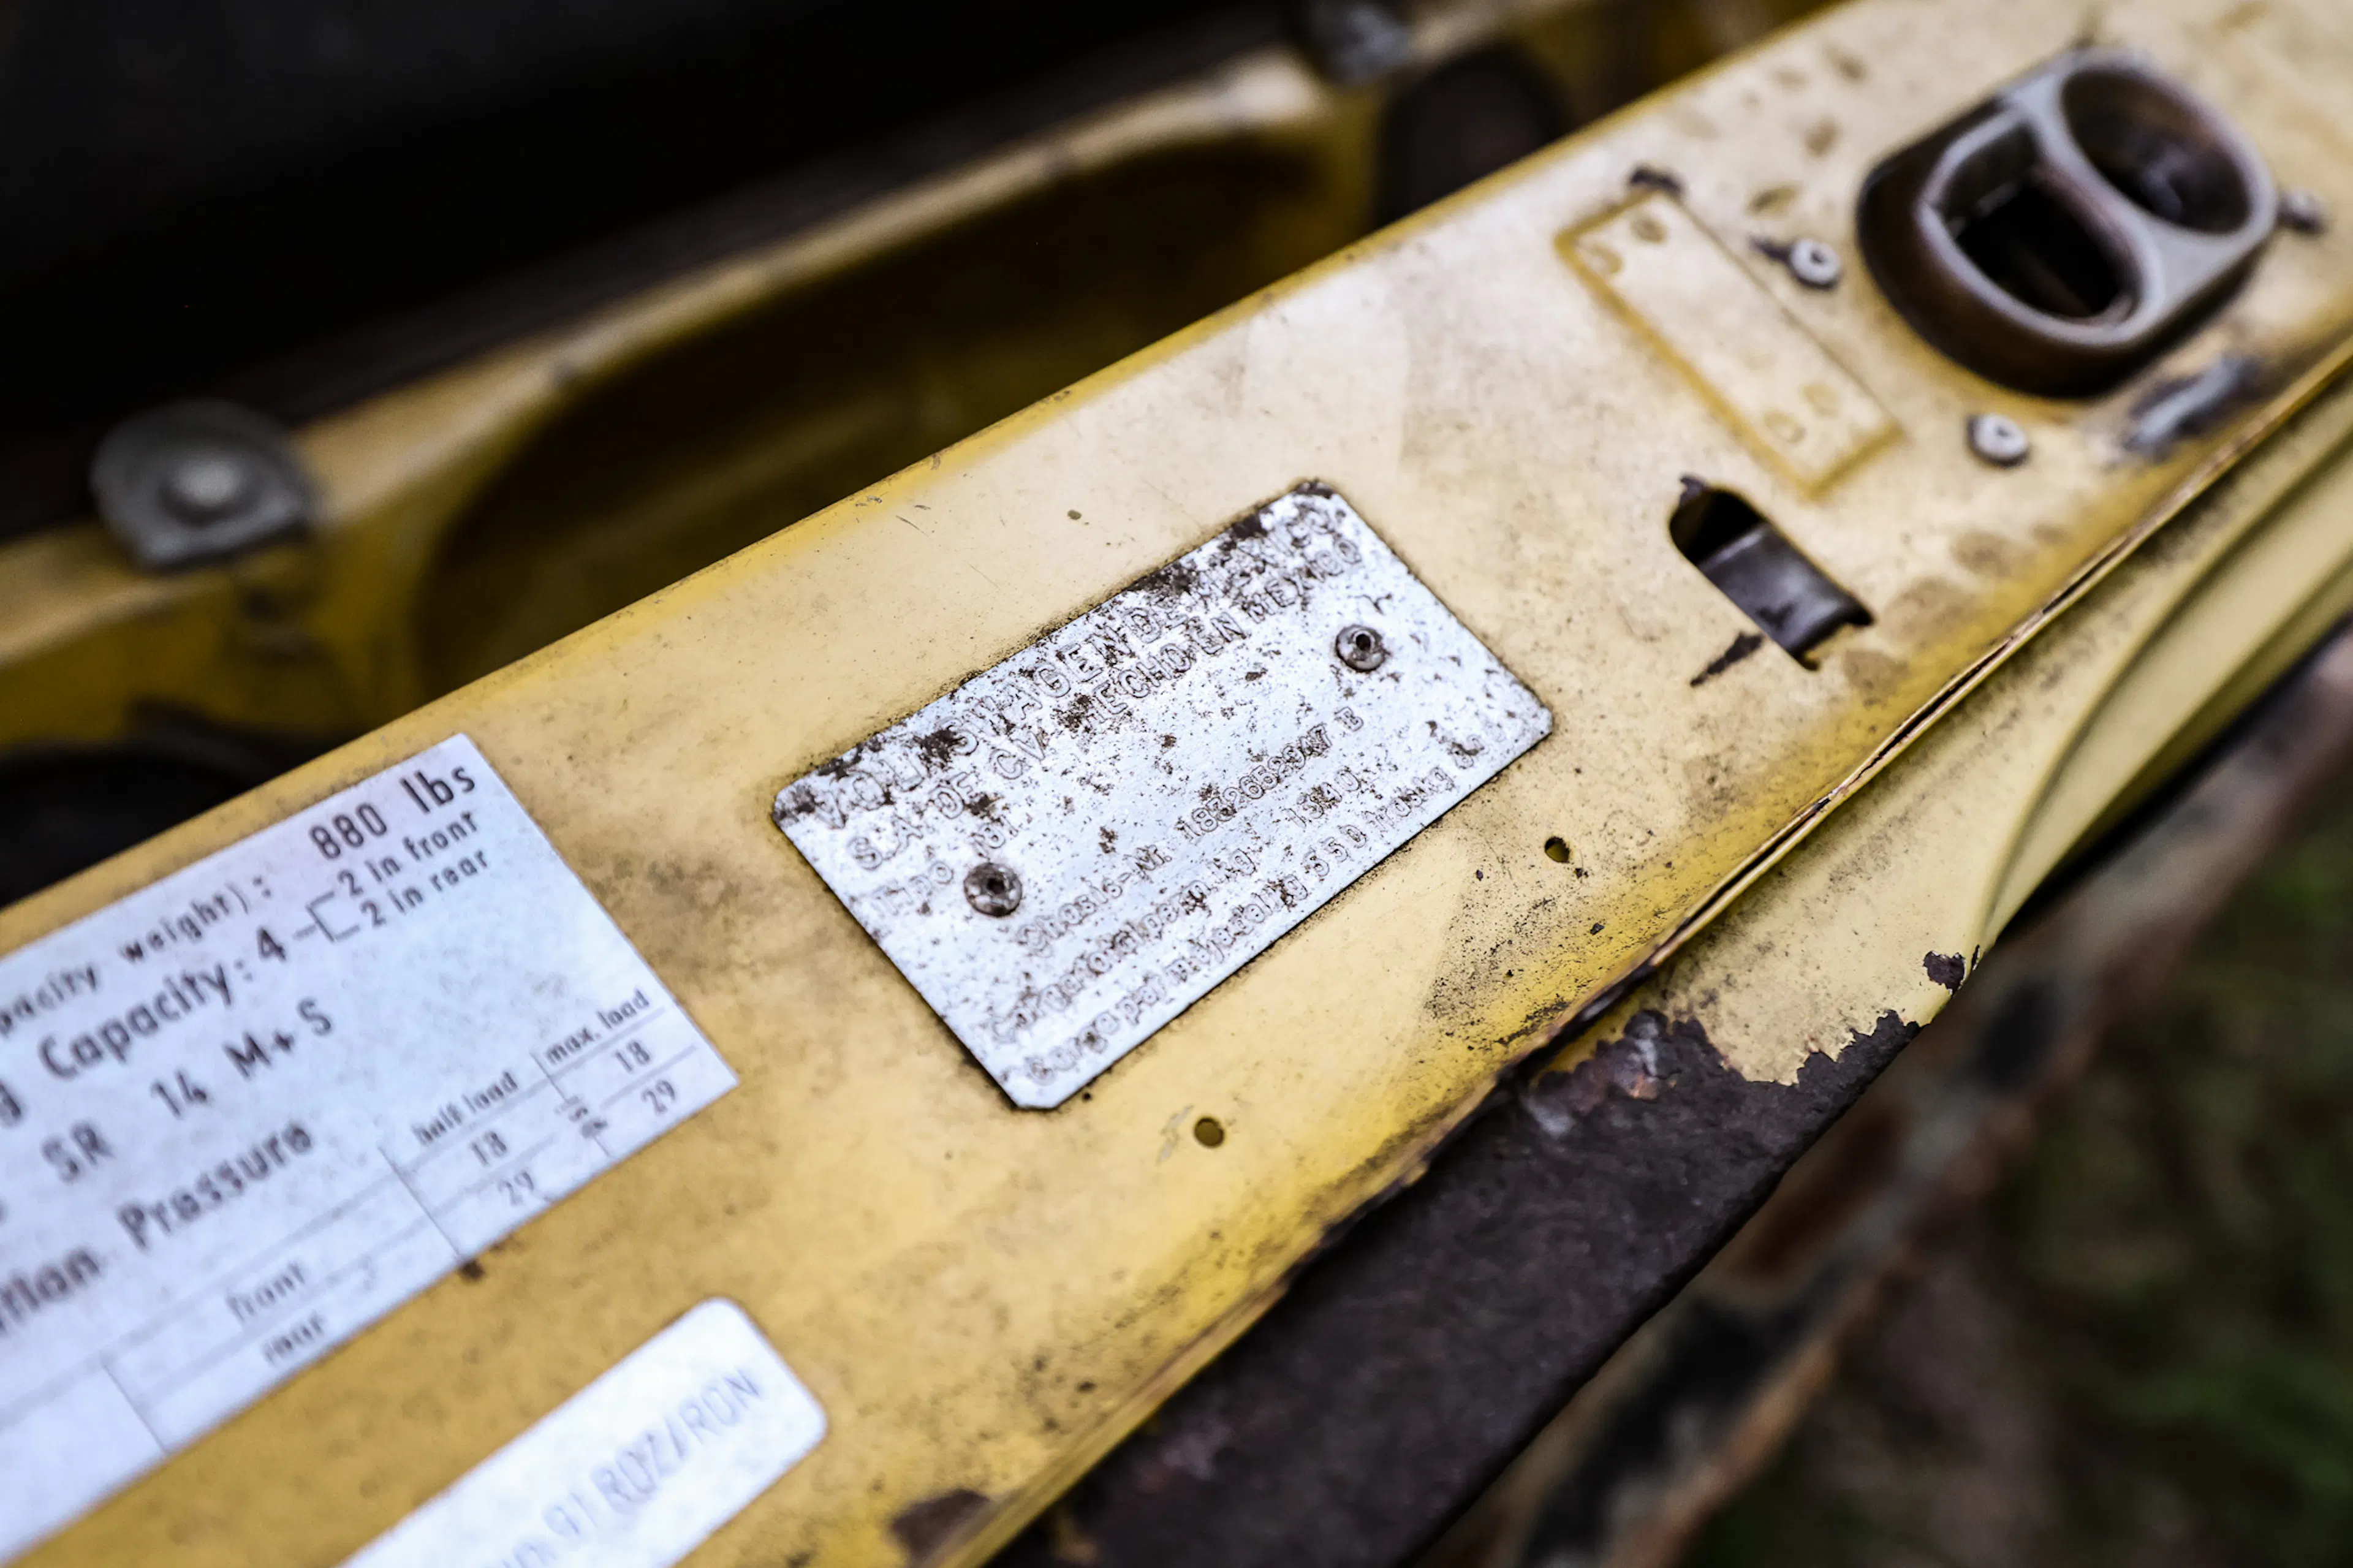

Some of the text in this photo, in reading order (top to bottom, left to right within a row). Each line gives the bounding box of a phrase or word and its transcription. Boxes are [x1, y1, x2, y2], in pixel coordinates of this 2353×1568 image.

[926, 770, 985, 820] DE
[1188, 610, 1246, 656] EN
[1236, 534, 1366, 624] MEXICO
[309, 802, 387, 861] 880
[399, 765, 476, 814] lbs
[337, 810, 479, 896] 2 in front
[361, 849, 488, 928] 2 in rear
[1205, 844, 1257, 890] kg
[38, 925, 287, 1080] Capacity: 4
[544, 986, 650, 1066] max. load
[613, 1037, 653, 1074] 18
[40, 1121, 116, 1184] SR
[150, 1068, 211, 1119] 14
[411, 1069, 518, 1147] half load
[641, 1078, 678, 1116] 29
[116, 1121, 313, 1252] Pressure
[469, 1131, 508, 1167] 18
[497, 1169, 535, 1208] 29
[225, 1262, 306, 1324] front
[260, 1310, 326, 1365] rear
